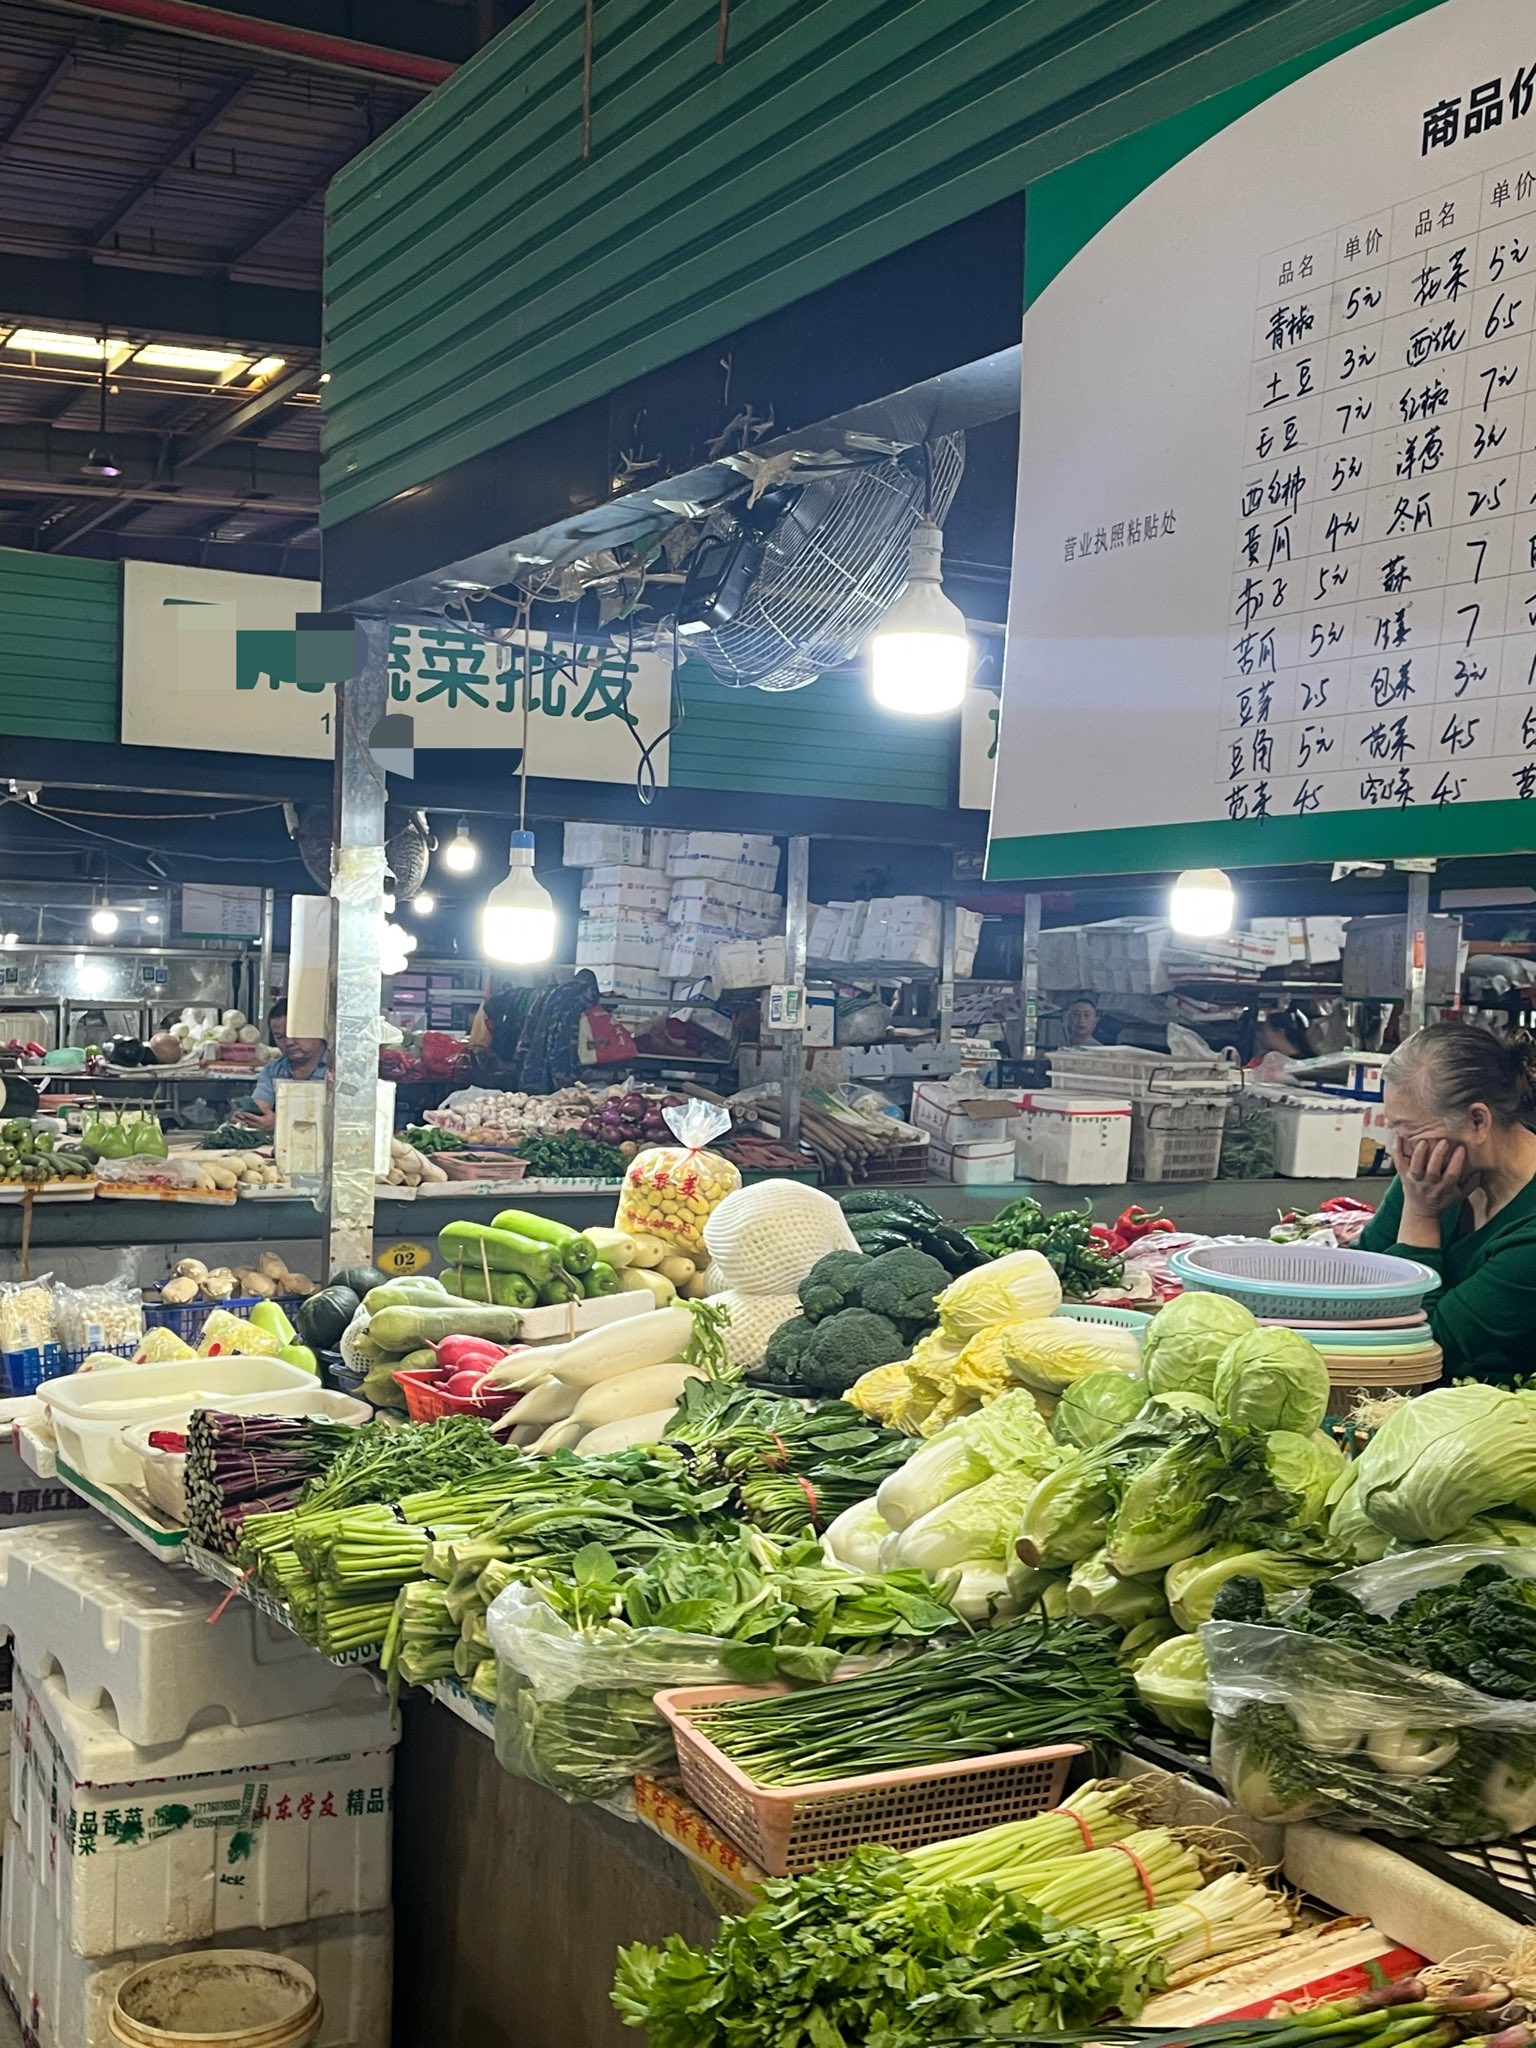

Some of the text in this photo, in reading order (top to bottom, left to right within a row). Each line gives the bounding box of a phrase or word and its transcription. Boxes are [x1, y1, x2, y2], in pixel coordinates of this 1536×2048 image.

[1278, 170, 1536, 286] 品名 单价 品名 单价
[1265, 238, 1529, 350] 青椒 5元 花菜 5元
[1264, 358, 1314, 407] 土豆
[1340, 345, 1376, 380] 3元
[1485, 292, 1522, 339] 6.5
[1256, 365, 1518, 459] 毛豆 7元 红椒 7元
[1242, 422, 1507, 517] 西红柿 5元 洋葱 3元
[1064, 508, 1177, 562] 营业执照粘贴处
[1241, 477, 1507, 572] 黄瓜 4元 冬瓜 2.5
[1314, 564, 1348, 601] 5元
[1466, 540, 1487, 584] 7
[1232, 627, 1277, 675] 苦瓜
[1309, 622, 1345, 658] 5元
[1457, 603, 1480, 648] 7
[1236, 680, 1275, 727] 豆芽
[1301, 678, 1330, 711] 2.5
[1370, 658, 1416, 708] 包菜
[1454, 660, 1487, 698] 3元
[1228, 728, 1274, 781] 豆角
[1297, 725, 1334, 769] 5元
[1360, 766, 1416, 813] 空心菜
[393, 1252, 416, 1267] 02
